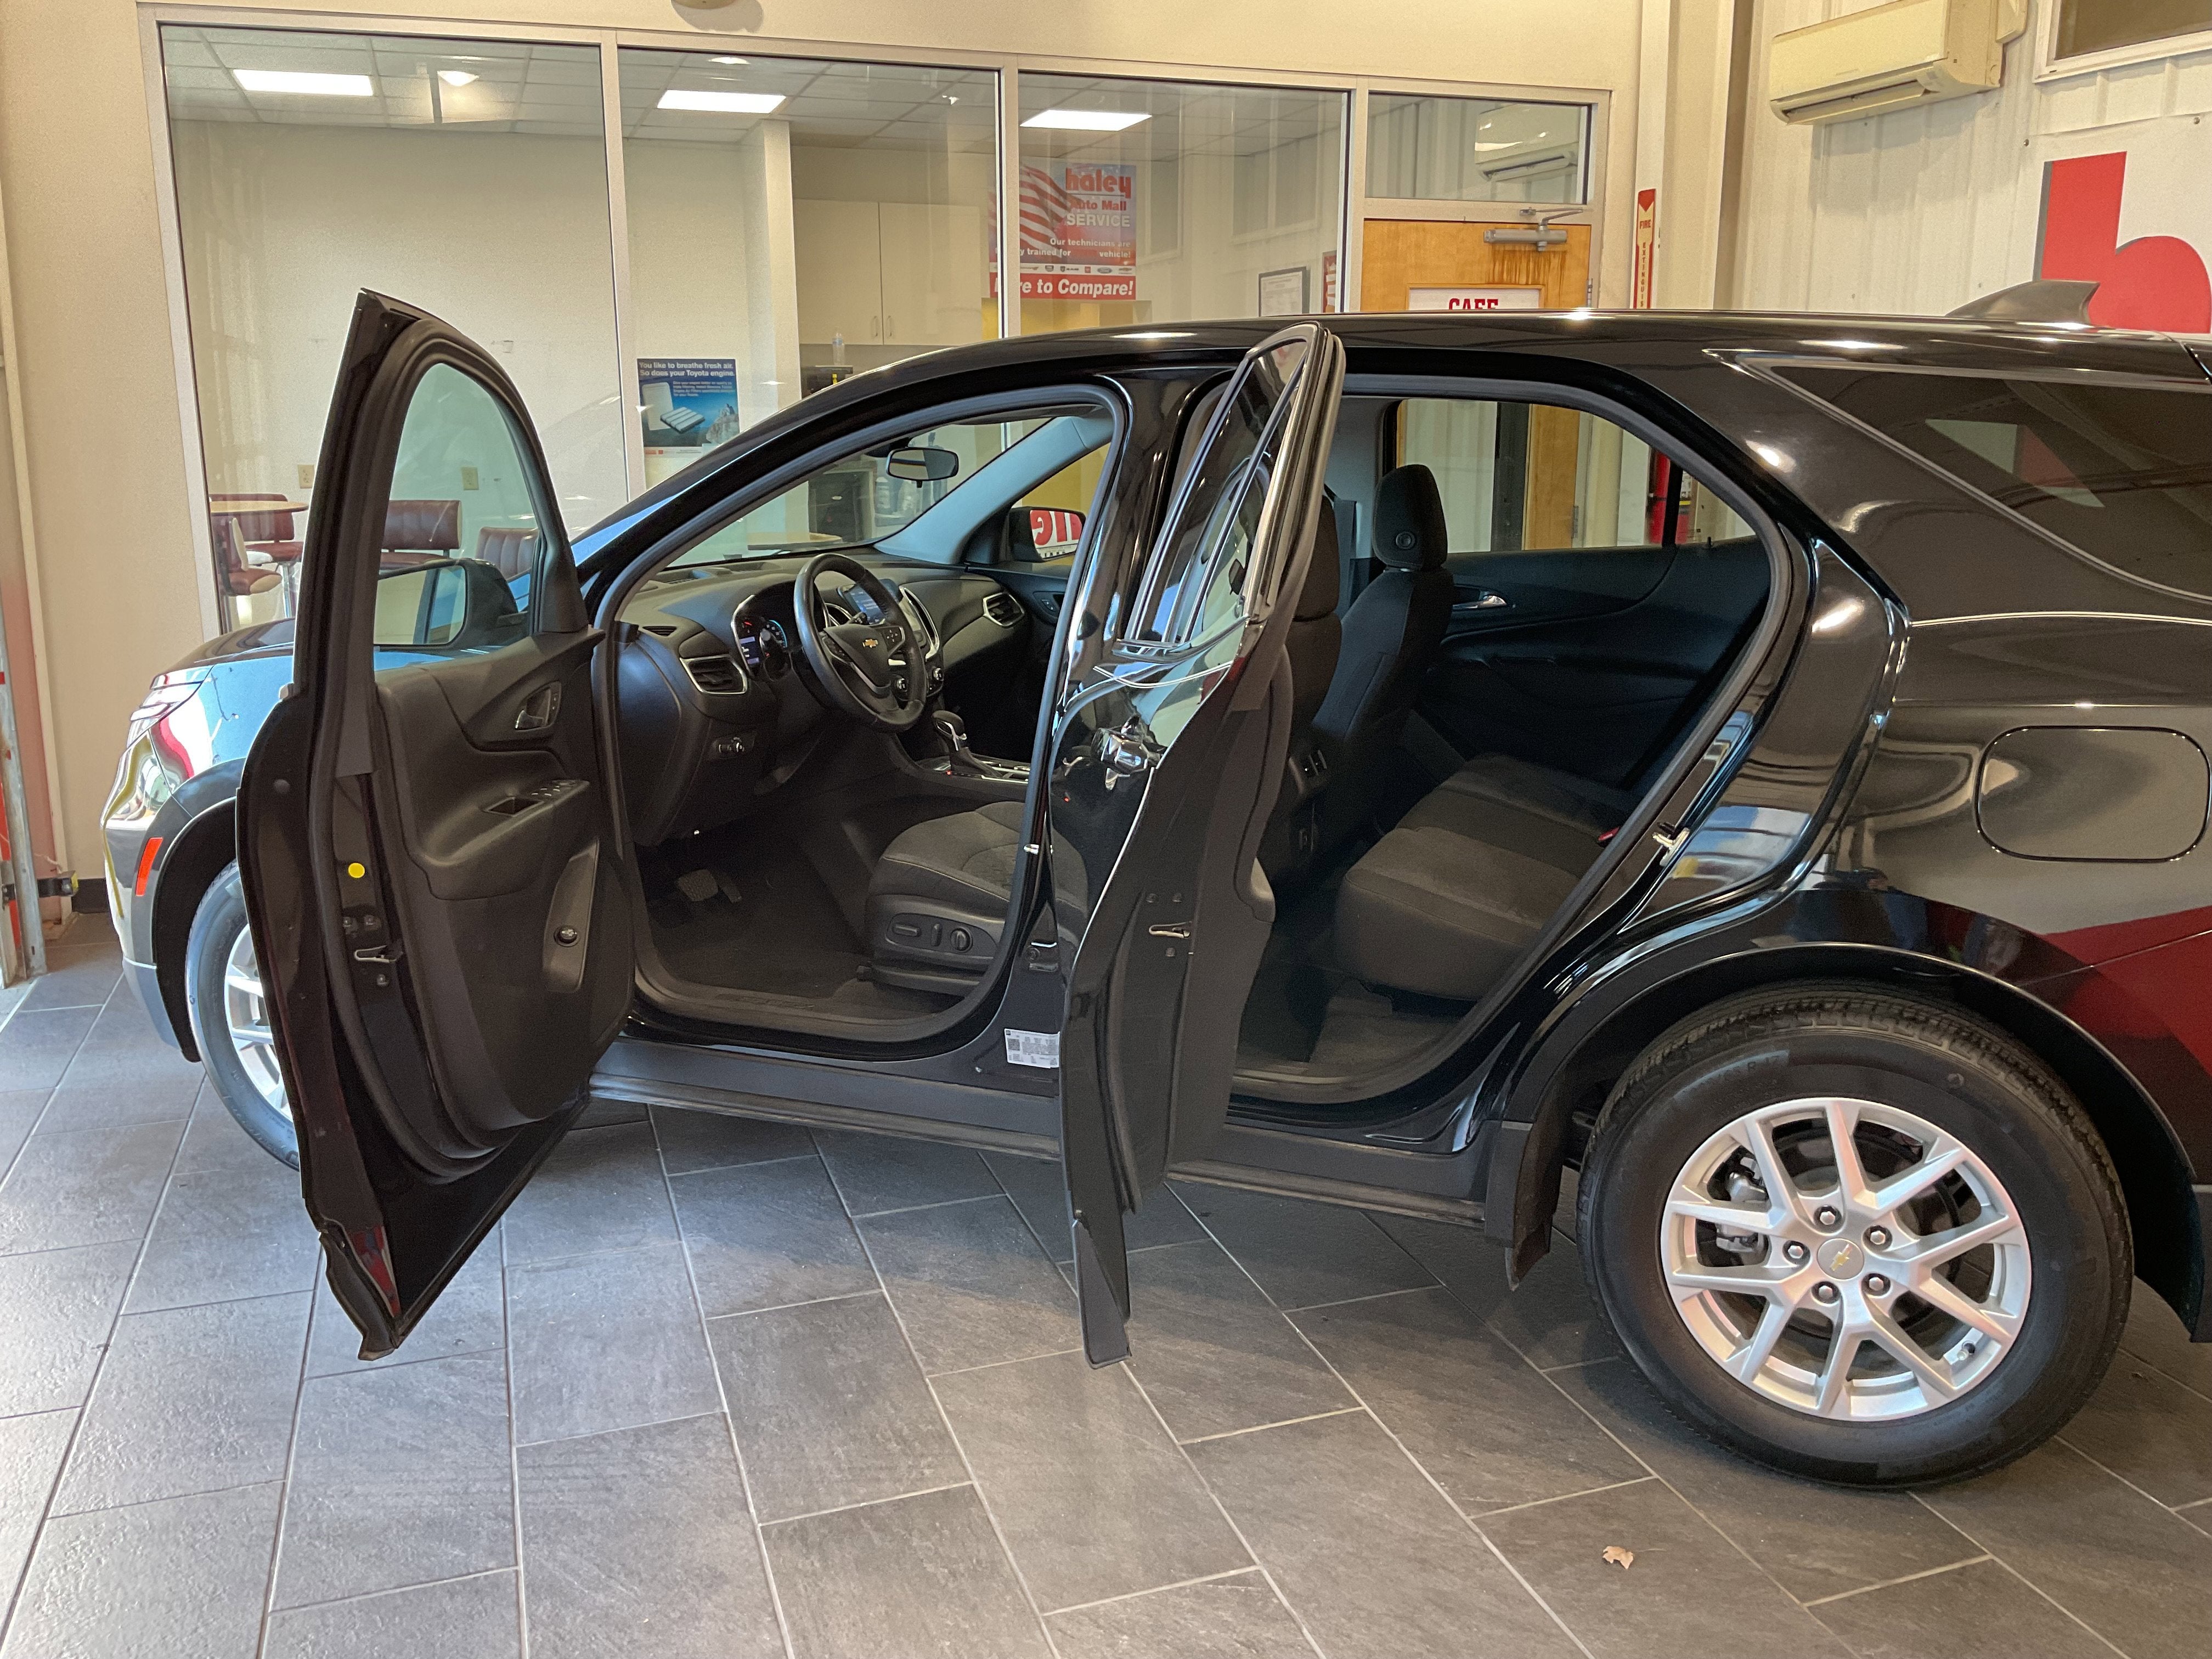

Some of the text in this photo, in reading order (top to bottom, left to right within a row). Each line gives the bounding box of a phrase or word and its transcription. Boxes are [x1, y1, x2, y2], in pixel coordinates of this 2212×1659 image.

[1066, 167, 1131, 199] haley
[1102, 200, 1126, 211] Mall
[1066, 213, 1130, 227] SERVICE
[1640, 219, 1651, 229] FIRE
[1068, 239, 1115, 247] technicians
[1059, 249, 1071, 257] for
[1037, 279, 1053, 294] to
[1058, 279, 1133, 298] Compare!
